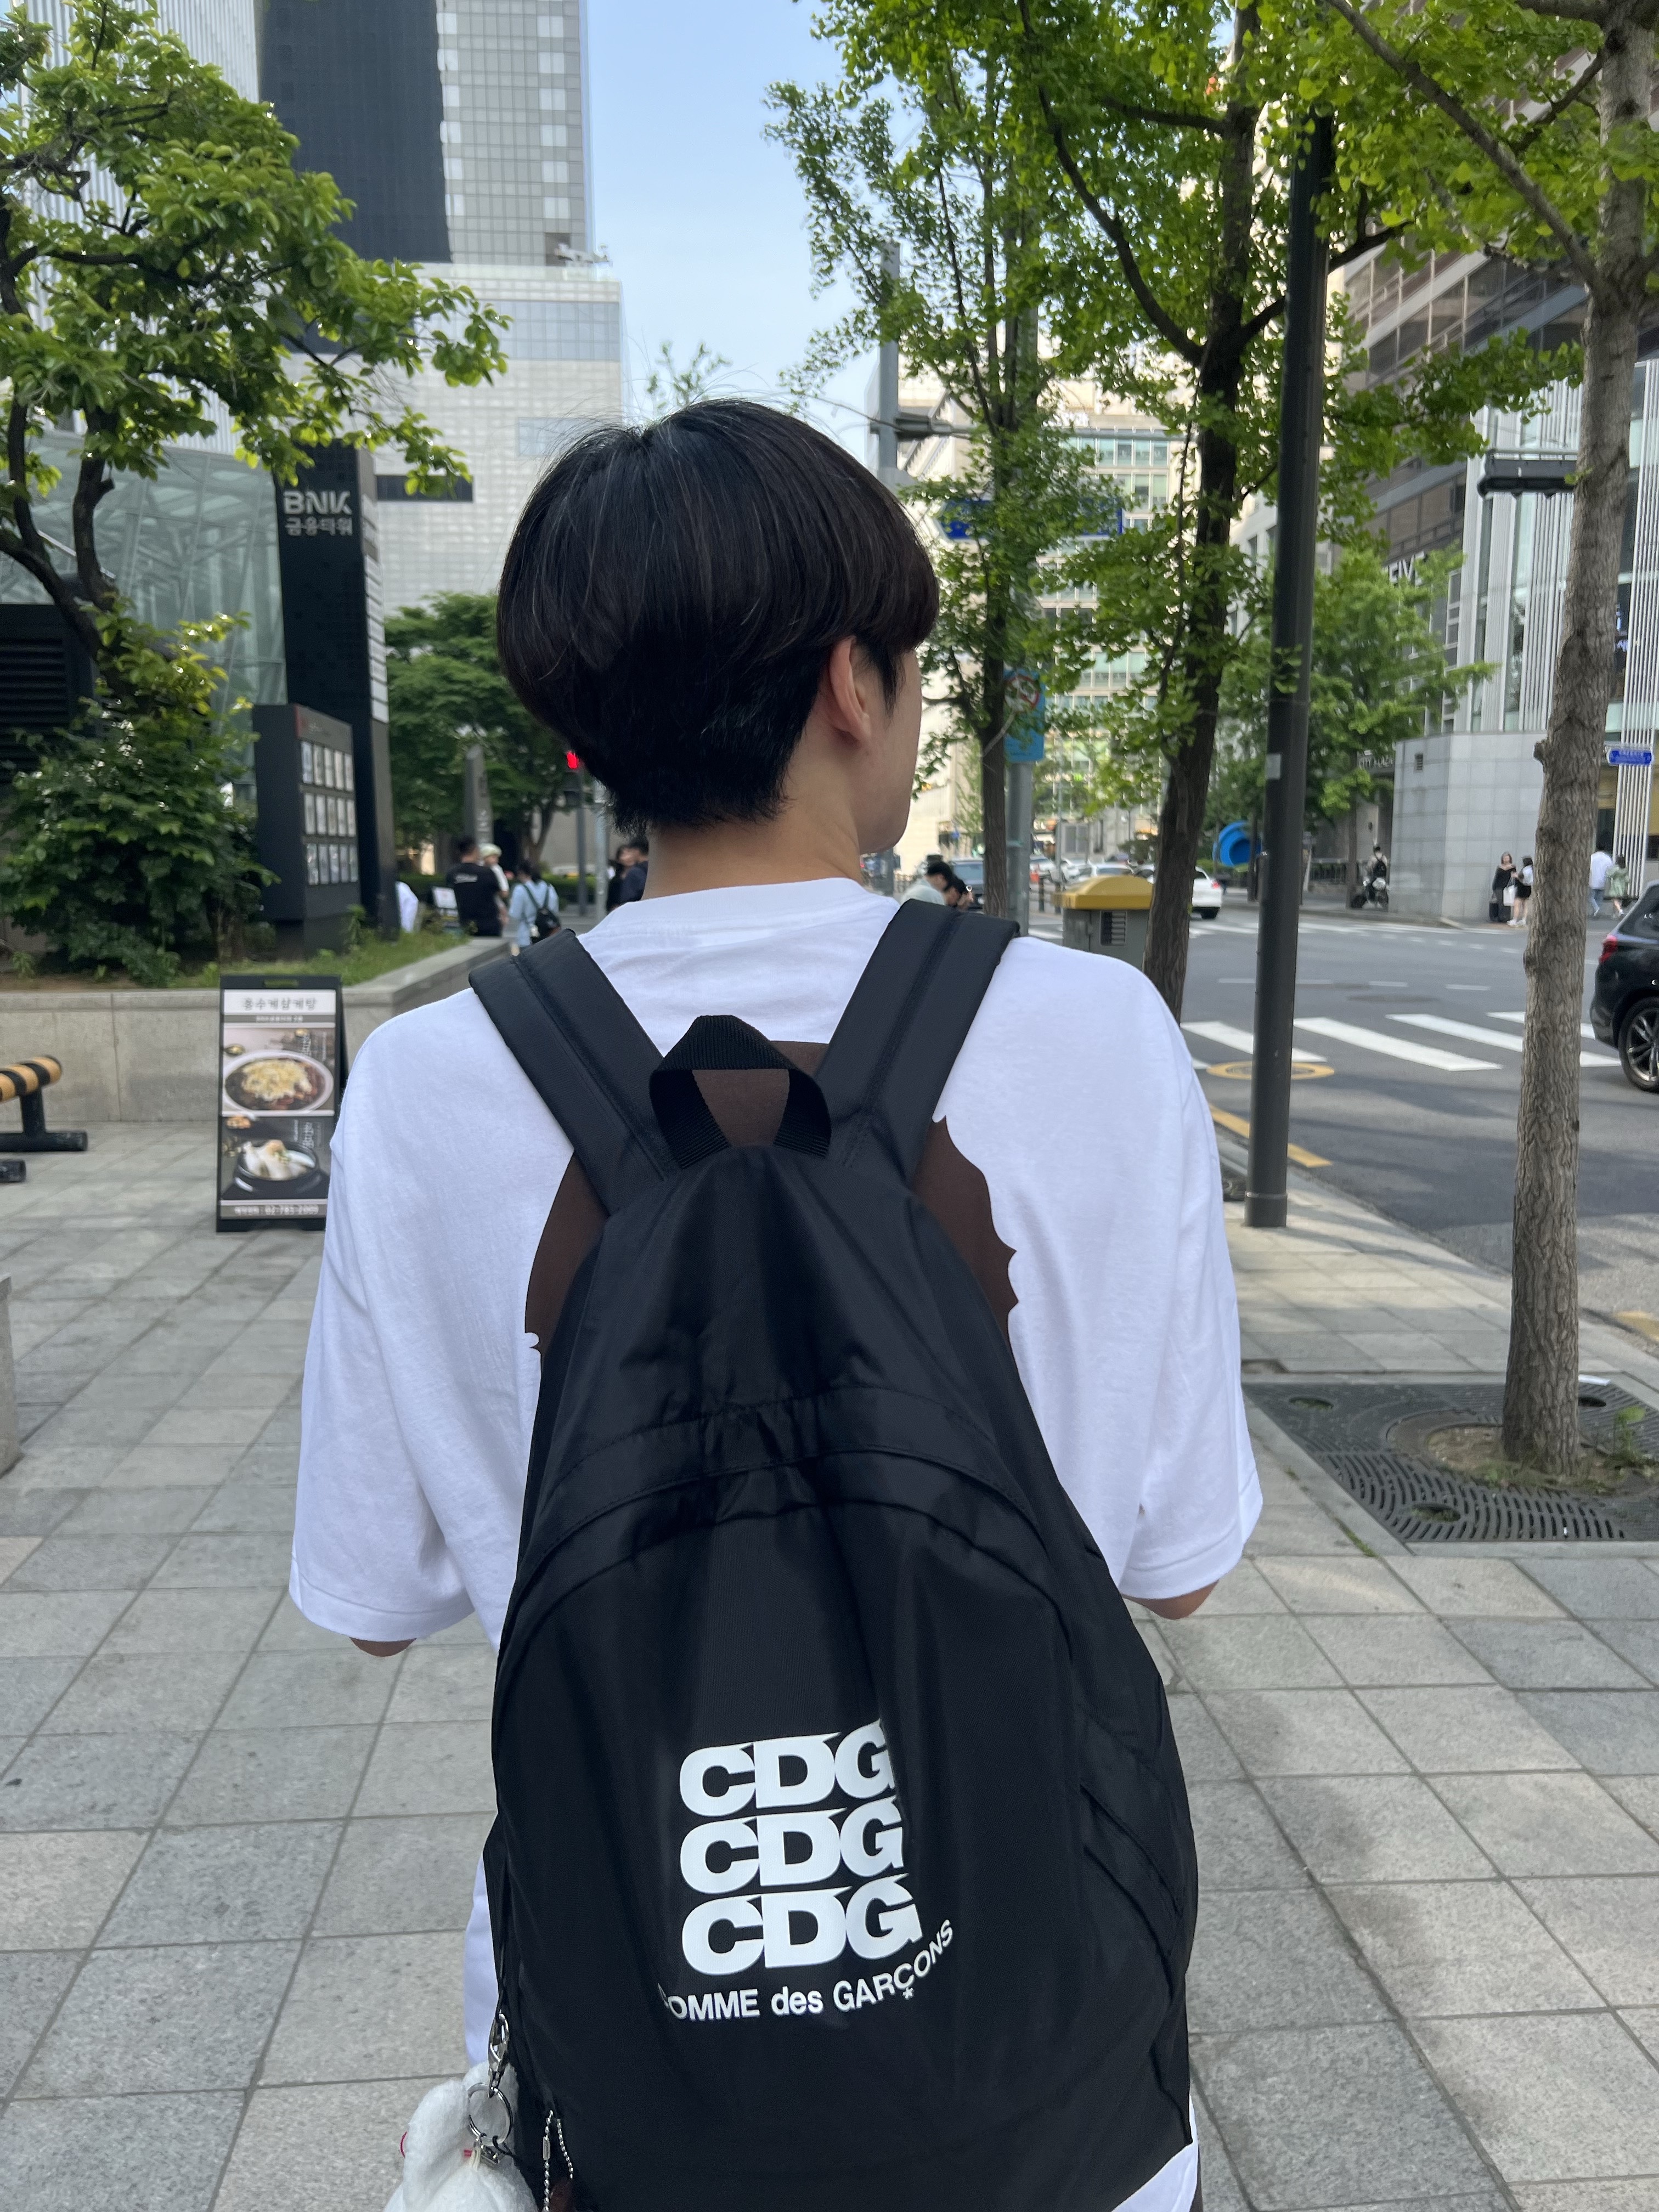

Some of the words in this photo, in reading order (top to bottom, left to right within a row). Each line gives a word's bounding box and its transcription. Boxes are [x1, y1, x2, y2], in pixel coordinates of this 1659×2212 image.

[283, 490, 352, 515] BNK
[680, 1718, 895, 1816] CDG
[680, 1795, 904, 1894] CDG
[658, 1982, 760, 2021] OMME
[771, 1986, 823, 2016] des
[833, 1920, 953, 2012] GARÇONS
[682, 1873, 923, 1975] CDG
